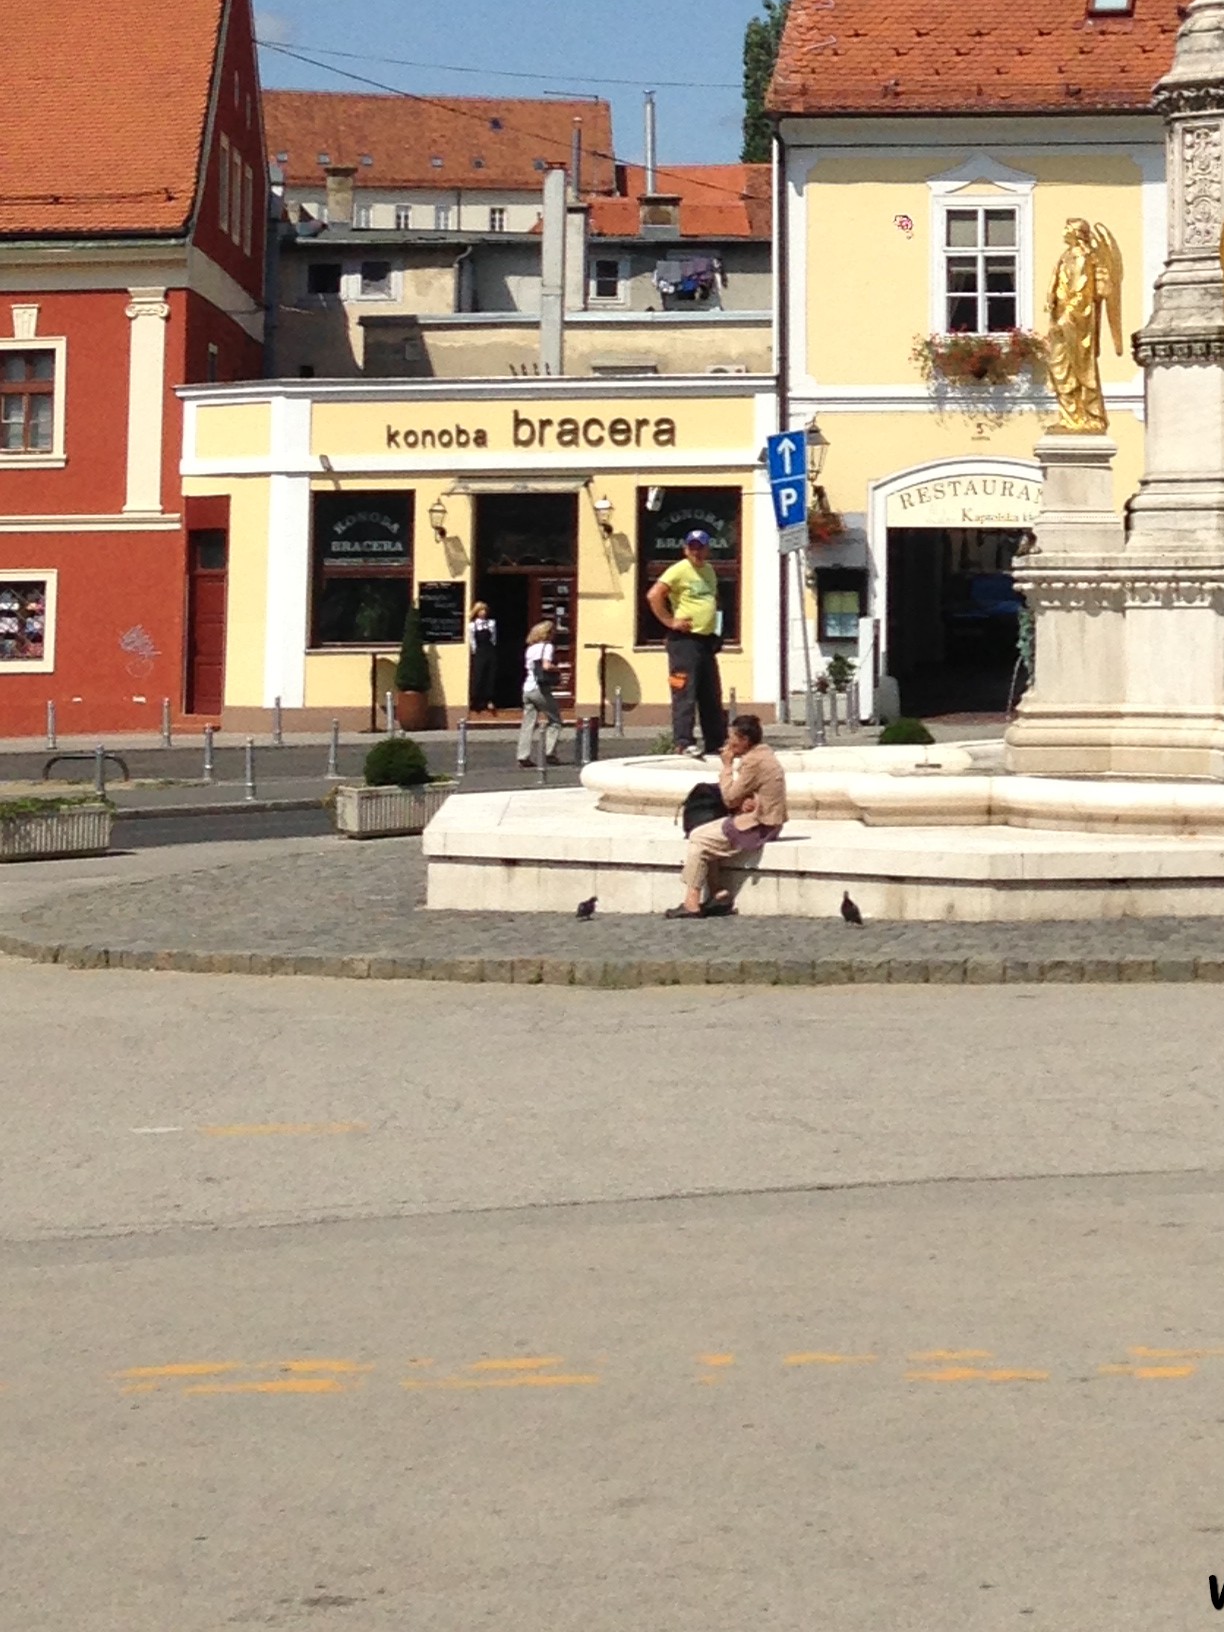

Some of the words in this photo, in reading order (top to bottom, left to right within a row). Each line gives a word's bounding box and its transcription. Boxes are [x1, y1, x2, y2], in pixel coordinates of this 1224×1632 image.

[386, 424, 488, 449] konoba
[512, 409, 676, 448] bracera
[779, 488, 798, 517] P
[333, 511, 400, 535] KONOBA
[331, 540, 403, 552] BRACERA
